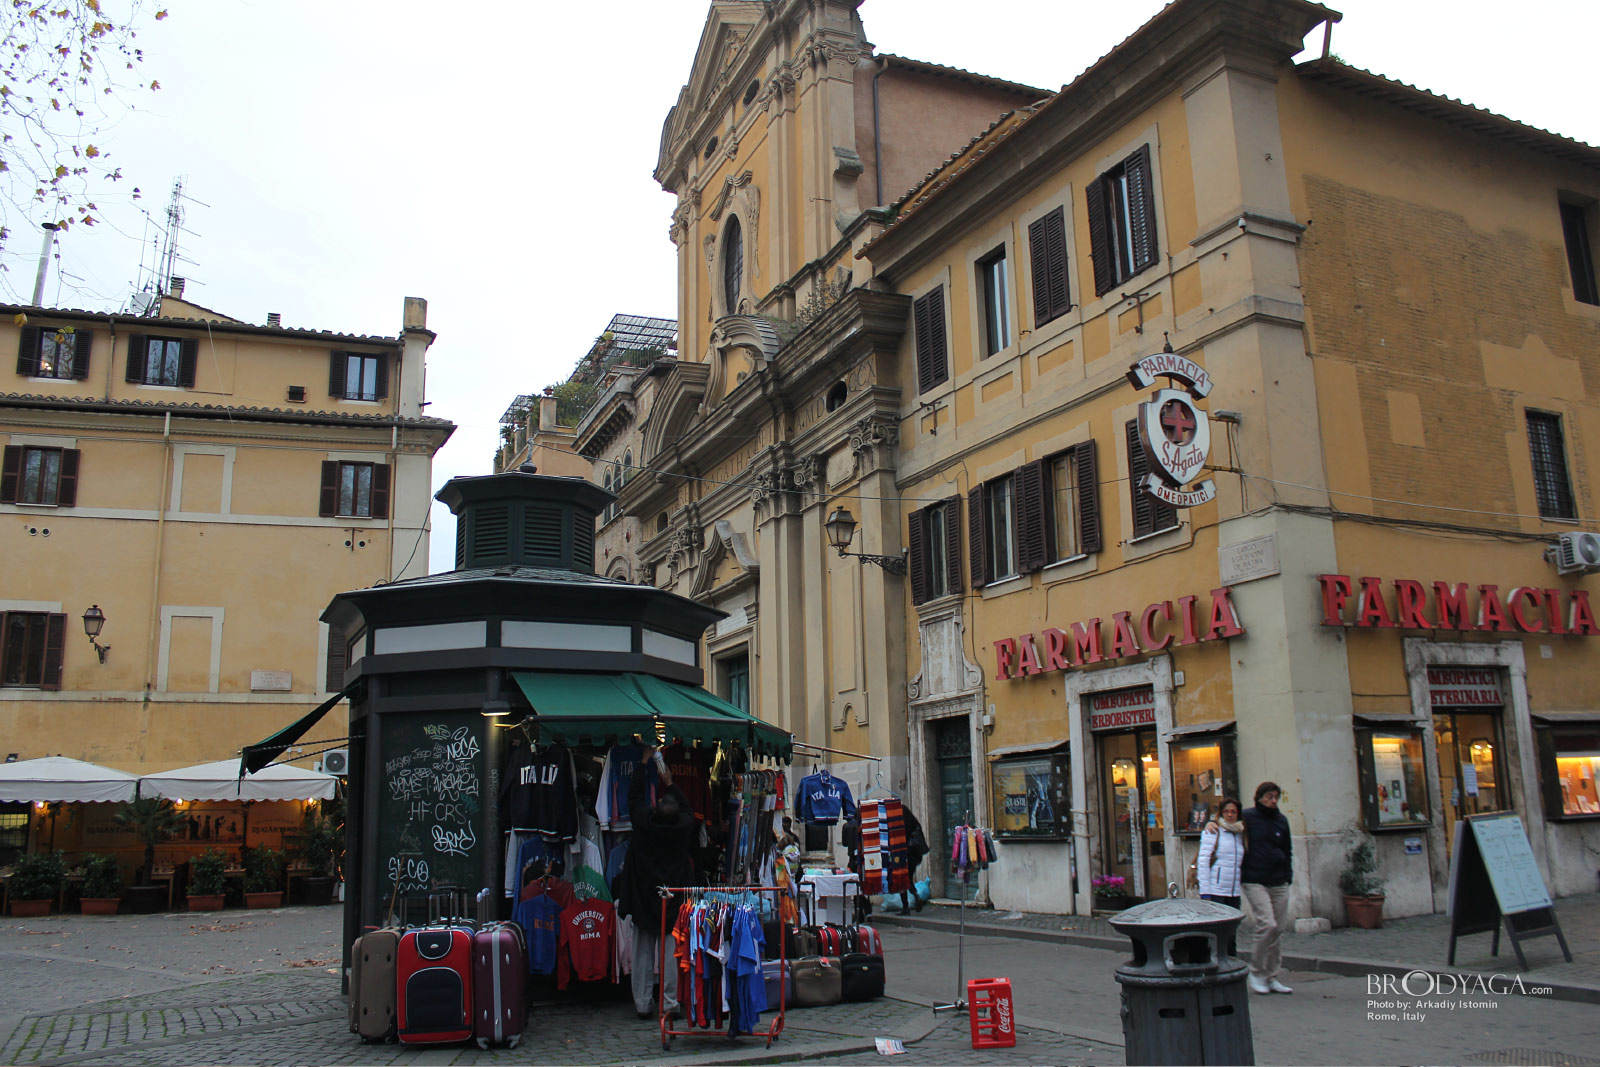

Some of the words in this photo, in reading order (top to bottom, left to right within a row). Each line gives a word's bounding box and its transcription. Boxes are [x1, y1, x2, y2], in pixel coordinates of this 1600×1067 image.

[1141, 355, 1206, 389] FARMACIA
[1157, 486, 1209, 505] OMEOPATICI
[1317, 574, 1600, 636] FARMACIA
[993, 586, 1247, 681] FARMACIA
